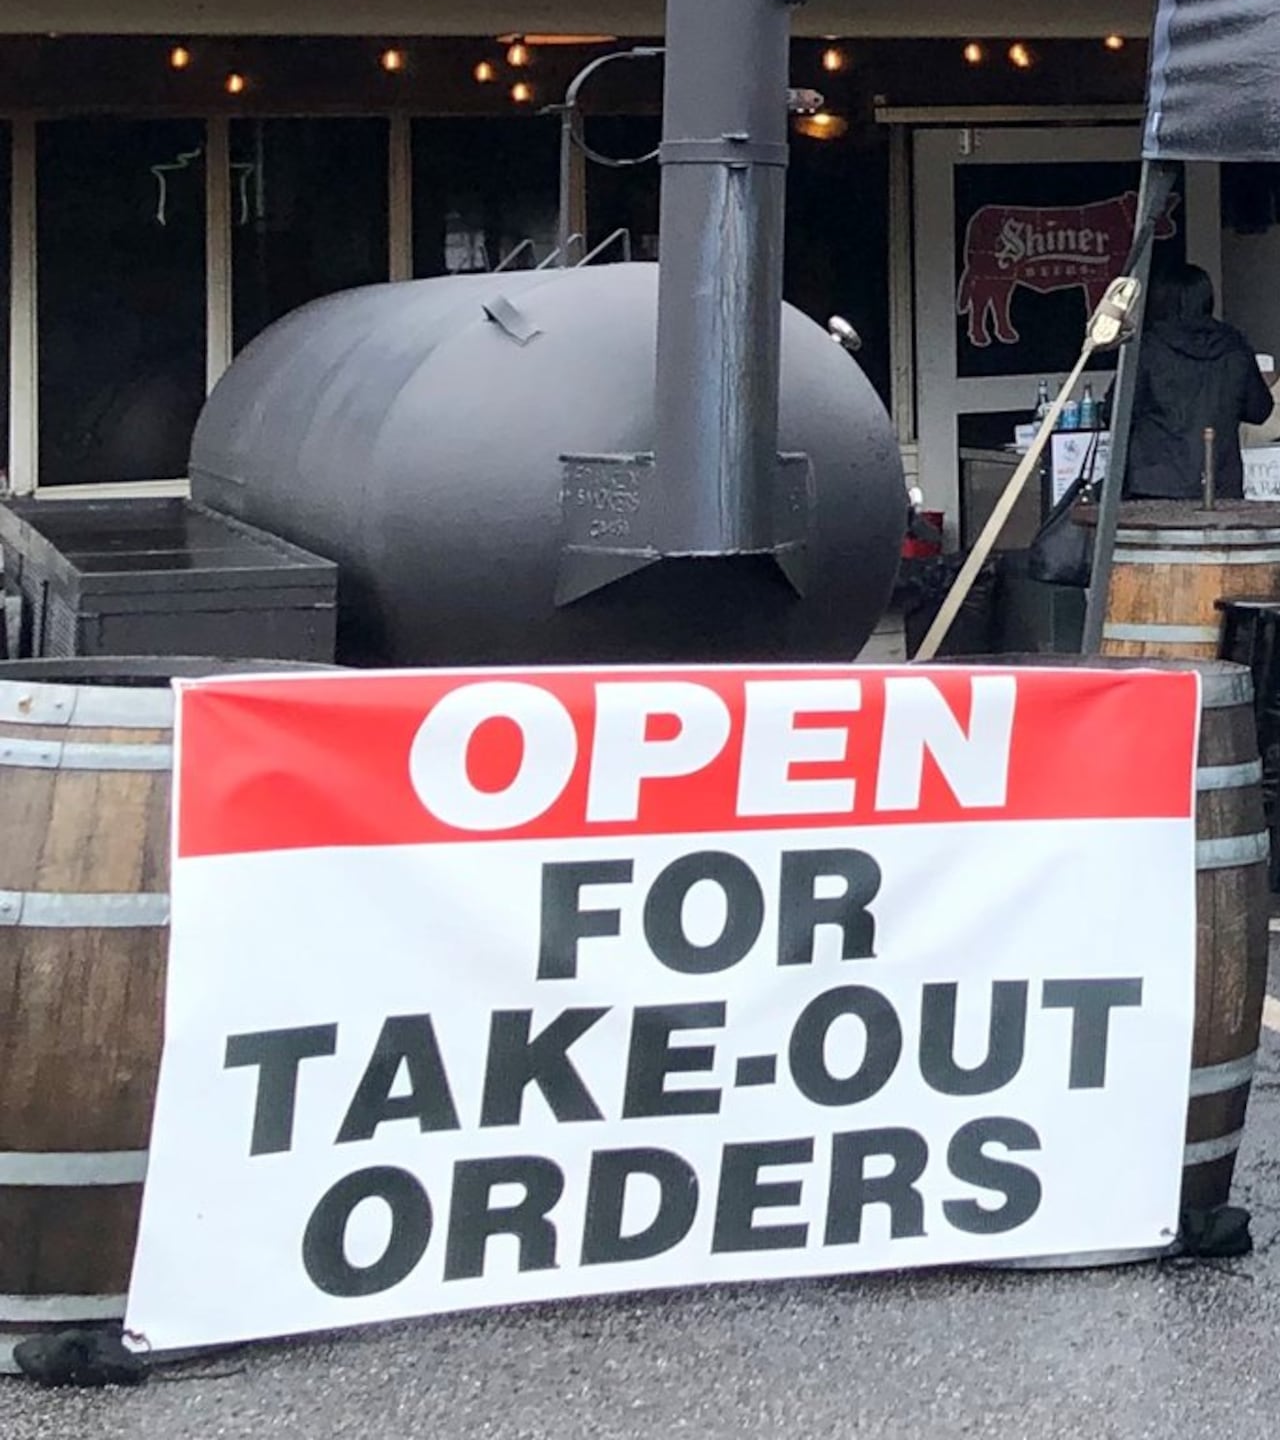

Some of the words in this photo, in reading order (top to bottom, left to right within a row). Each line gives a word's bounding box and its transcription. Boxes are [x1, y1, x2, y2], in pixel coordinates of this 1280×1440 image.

[994, 217, 1110, 269] Shiner
[407, 675, 1017, 831] OPEN
[535, 847, 883, 981] FOR
[223, 975, 1143, 1157] TAKE-OUT
[301, 1115, 1042, 1299] ORDERS
